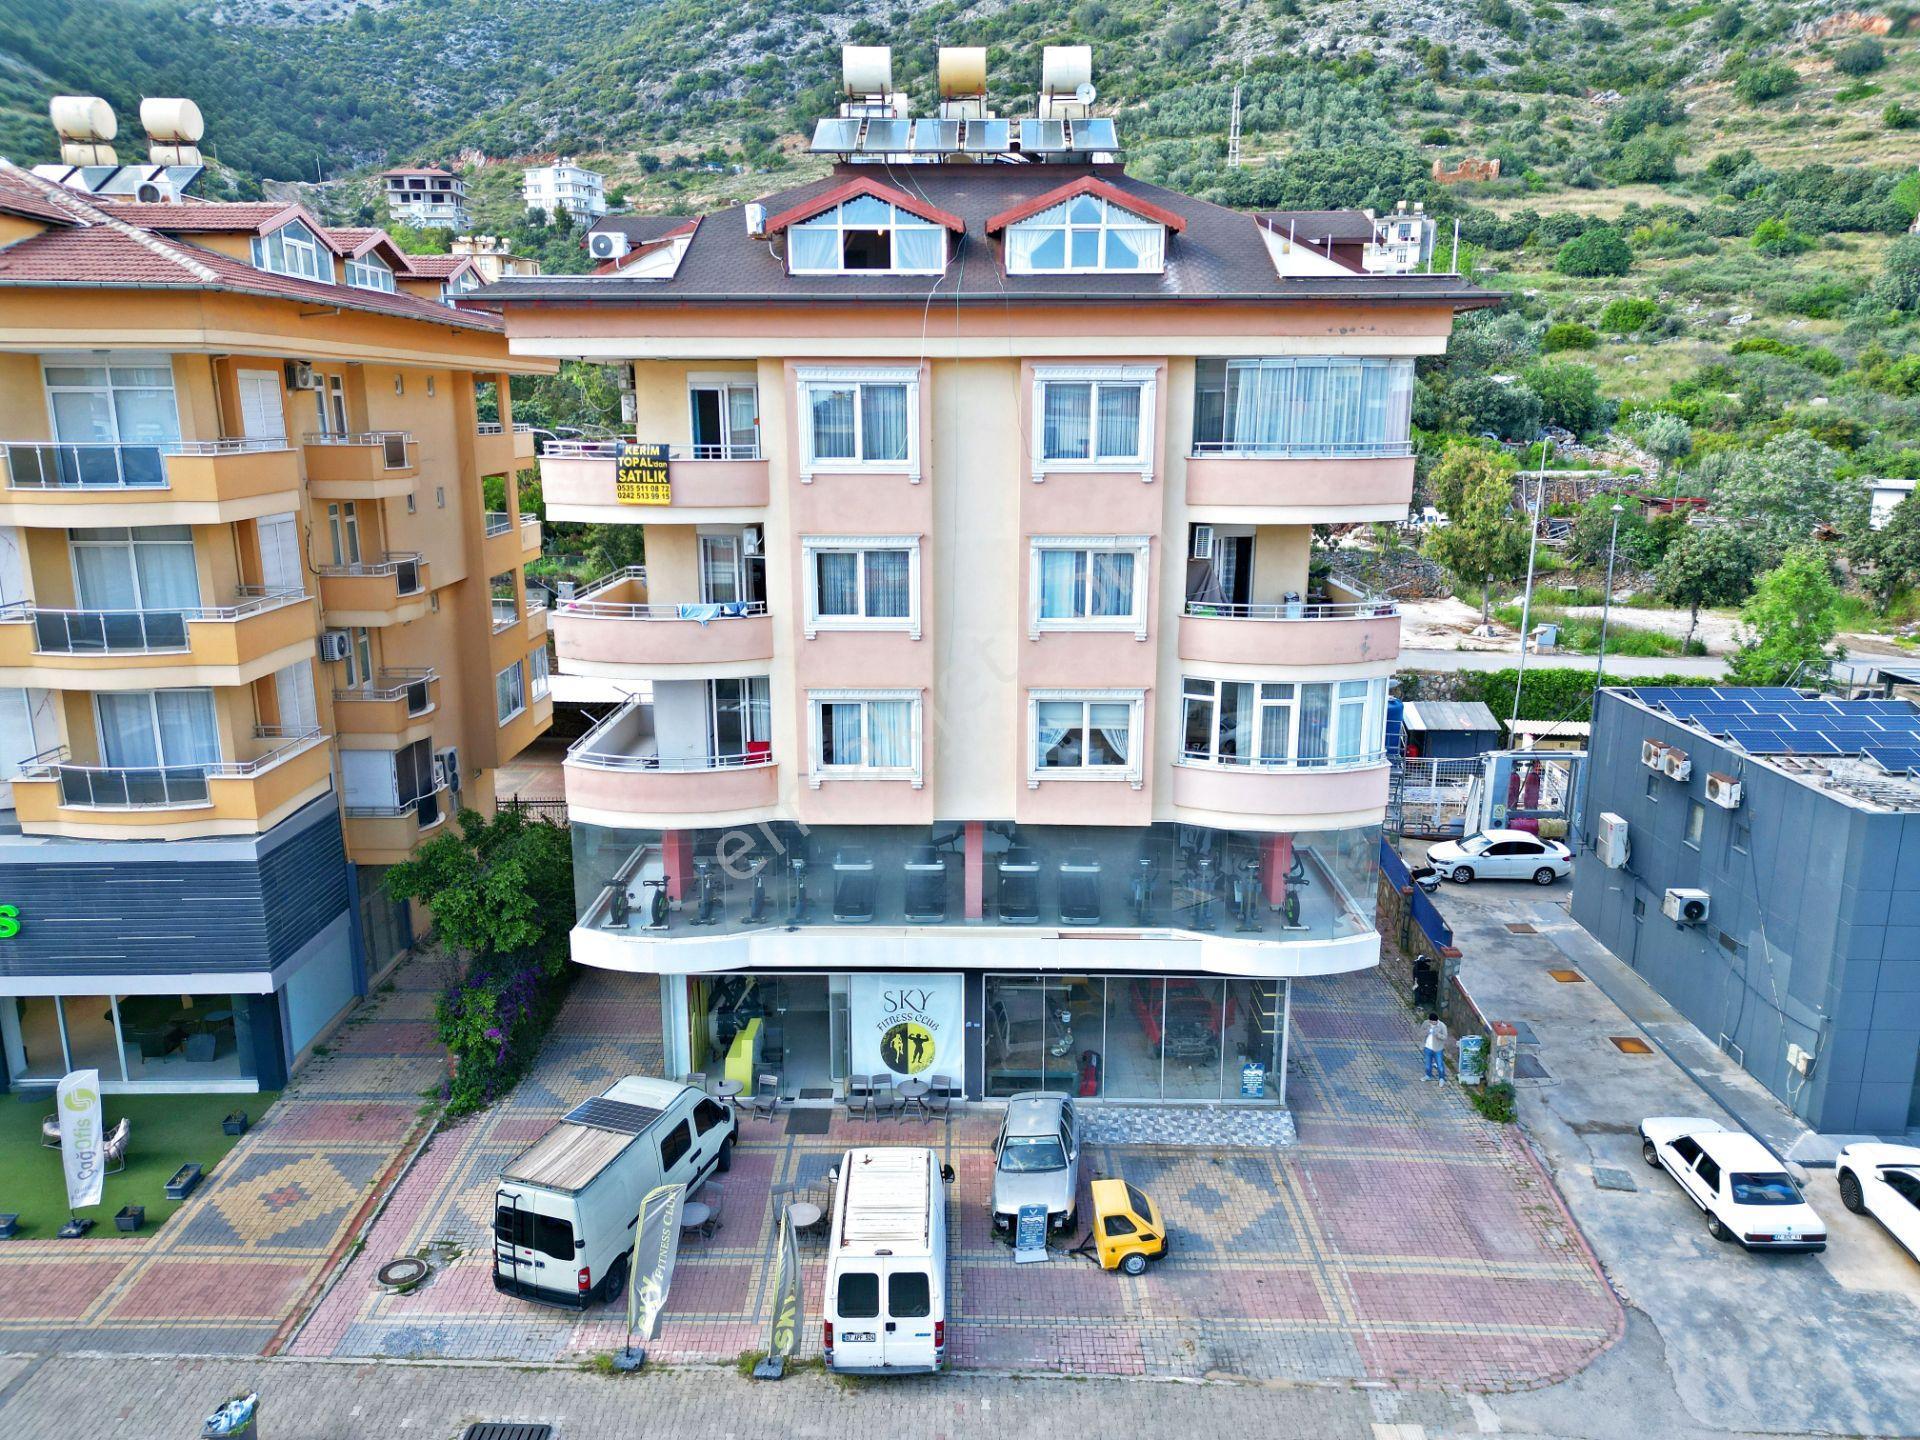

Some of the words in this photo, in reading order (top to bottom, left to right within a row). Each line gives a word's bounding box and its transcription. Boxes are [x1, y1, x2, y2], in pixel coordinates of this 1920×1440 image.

[618, 469, 667, 483] SATILIK
[883, 988, 936, 1013] SKY
[876, 1012, 913, 1032] FITNESS
[914, 1013, 940, 1032] CLUB
[655, 1229, 671, 1281] FITNESS
